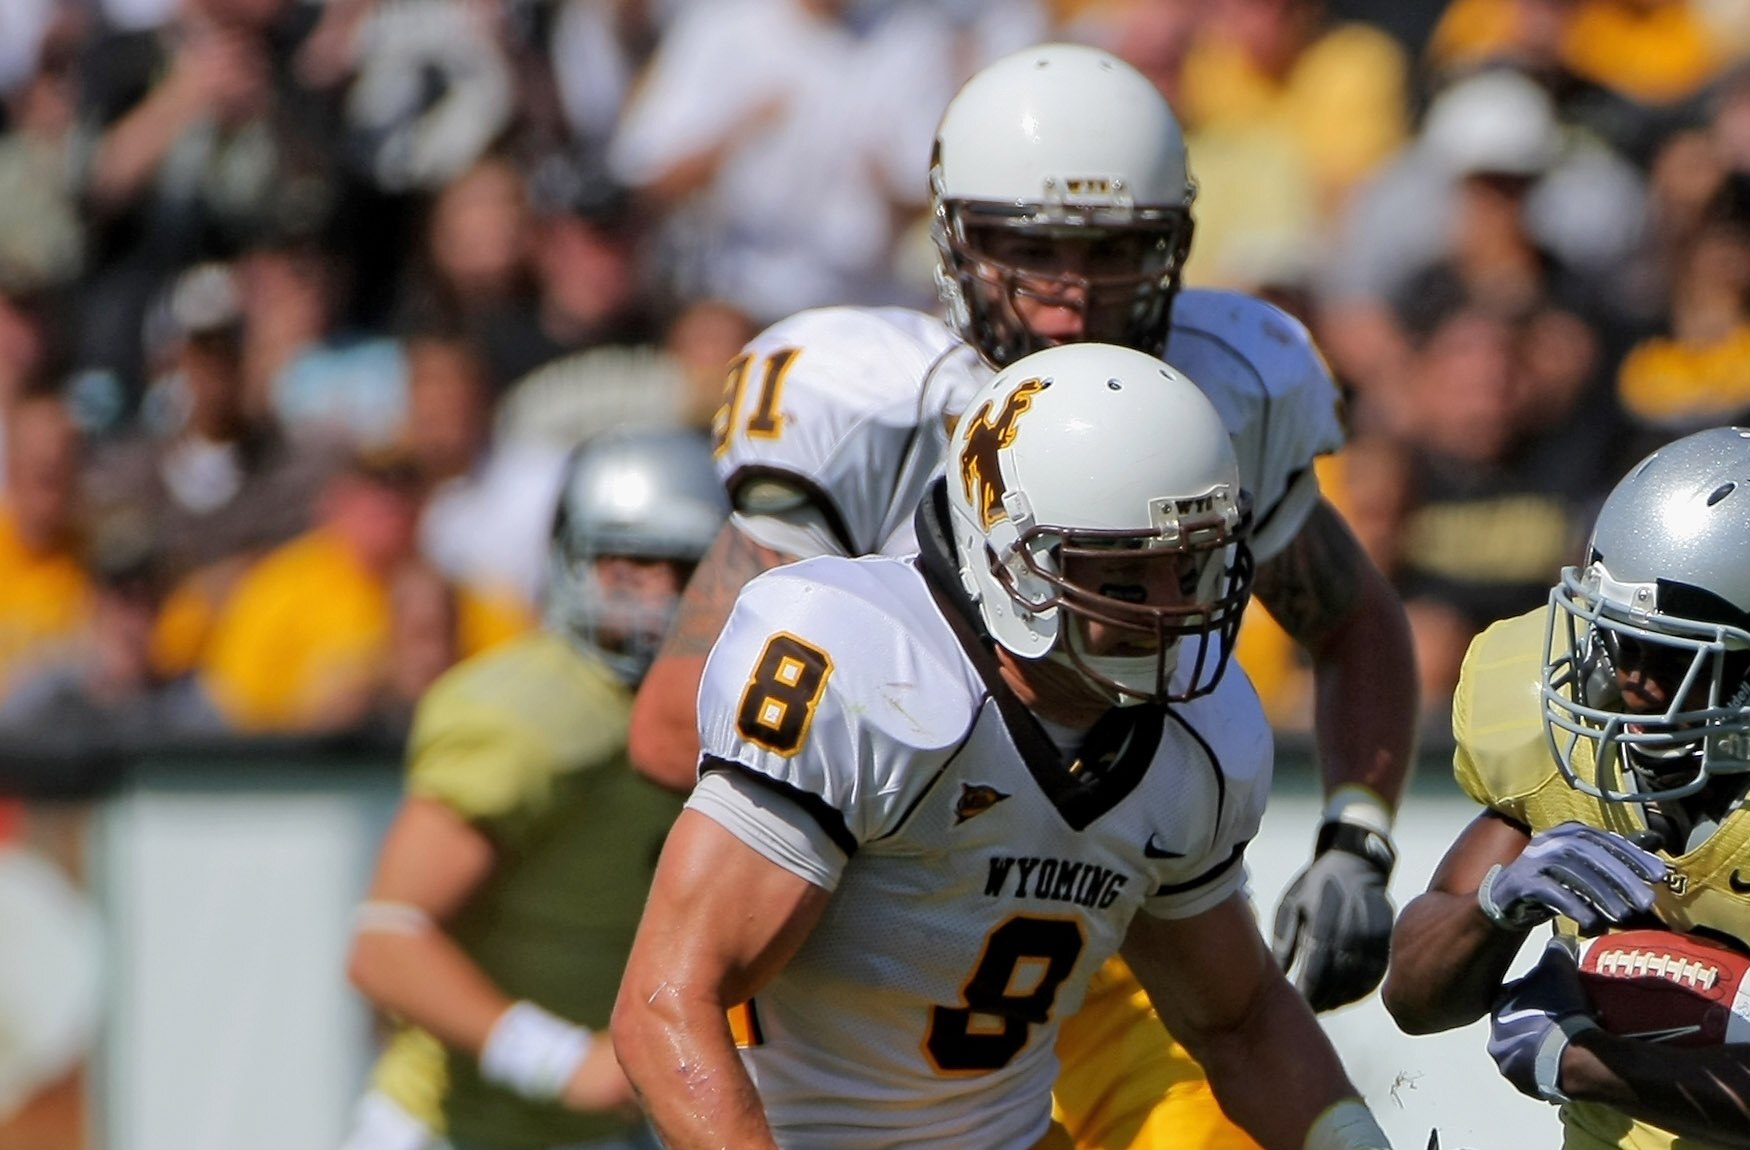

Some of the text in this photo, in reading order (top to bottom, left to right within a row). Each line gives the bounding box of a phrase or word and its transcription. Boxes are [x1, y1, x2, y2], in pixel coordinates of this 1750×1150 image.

[733, 630, 834, 757] 8
[984, 857, 1129, 909] WYOMING
[920, 912, 1088, 1079] 8
